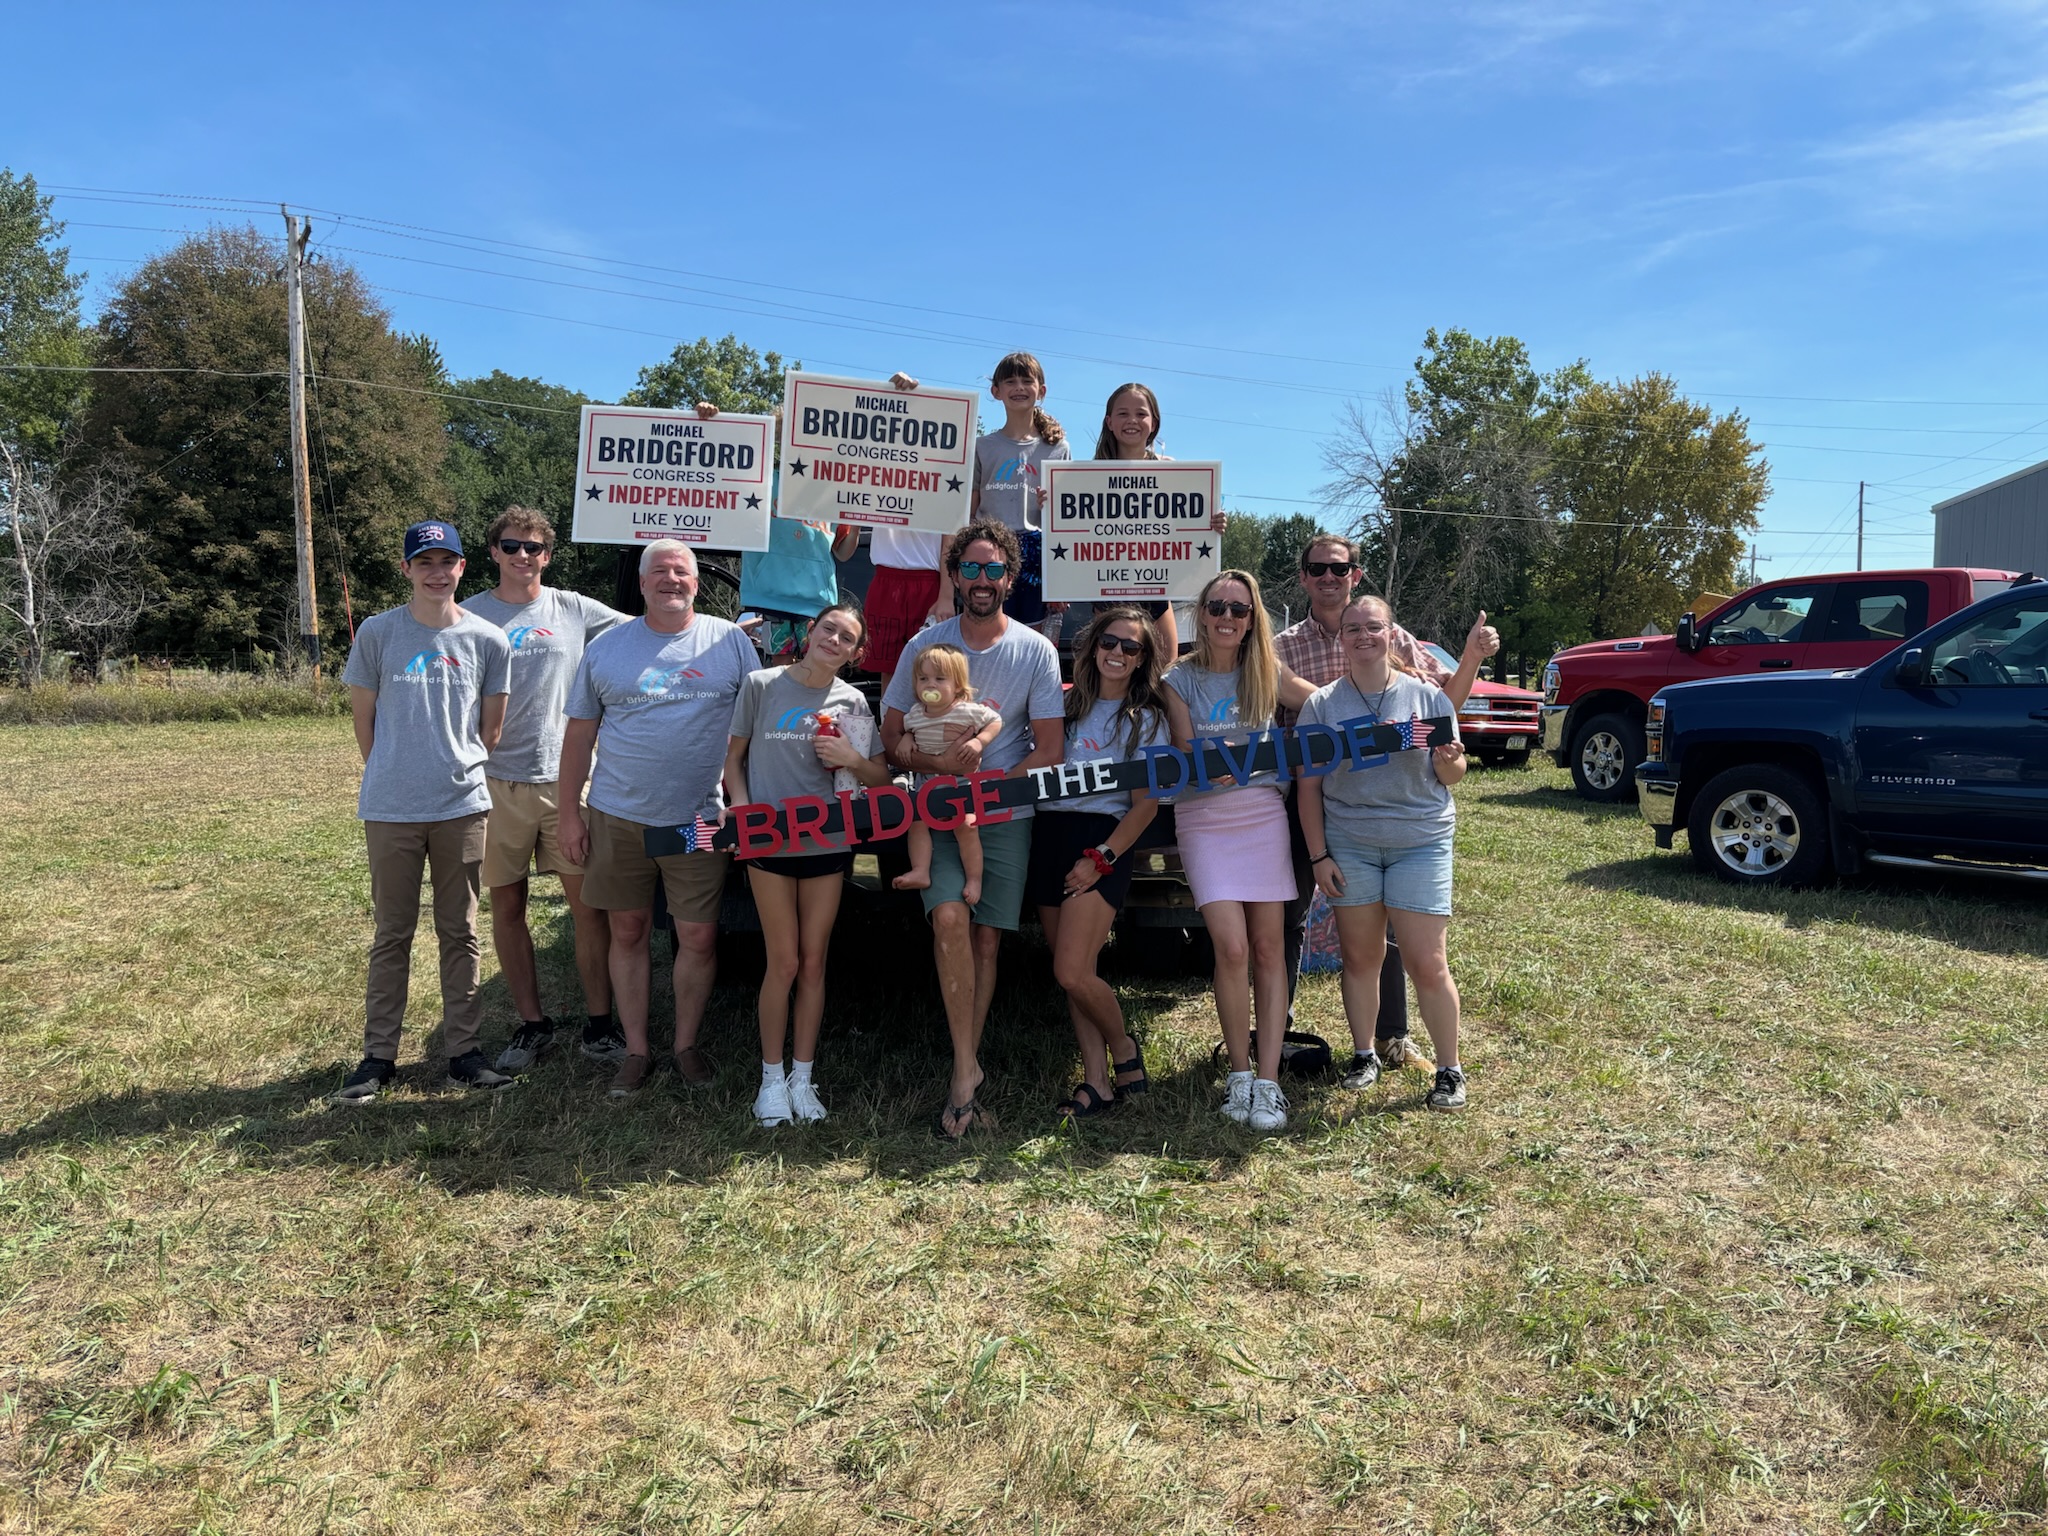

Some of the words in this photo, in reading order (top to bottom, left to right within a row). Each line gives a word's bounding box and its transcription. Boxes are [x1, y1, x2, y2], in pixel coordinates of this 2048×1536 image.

[855, 395, 909, 414] MICHAEL
[650, 423, 705, 438] MICHAEL
[803, 407, 957, 450] BRIDGFORD
[598, 436, 754, 470] BRIDGFORD
[837, 443, 919, 463] CONGRESS
[633, 468, 716, 484] CONGRESS
[813, 459, 942, 493] INDEPENDENT
[1108, 476, 1159, 489] MICHAEL
[985, 482, 1019, 491] Bridgford
[608, 484, 740, 510] INDEPENDENT
[837, 490, 871, 507] LIKE
[876, 494, 914, 511] YOU!
[1060, 492, 1204, 520] BRIDGFORD
[632, 512, 668, 526] LIKE
[673, 514, 712, 528] YOU!
[417, 530, 445, 543] 250
[418, 525, 444, 533] AMERICA
[1094, 523, 1171, 536] CONGRESS
[1073, 541, 1193, 562] INDEPENDENT
[1097, 568, 1130, 582] LIKE
[1133, 568, 1169, 581] YOU!
[533, 647, 547, 655] For
[392, 674, 435, 685] Bridgford
[626, 692, 675, 704] Bridgford
[677, 692, 695, 700] For
[697, 691, 721, 699] Iowa
[1197, 721, 1237, 732] Bridgford
[764, 731, 806, 741] Bridgford
[729, 769, 1013, 861] BRIDGE
[1027, 757, 1118, 801] THE
[1139, 713, 1390, 800] DIVIDE
[1871, 775, 1956, 786] SILVERADO
